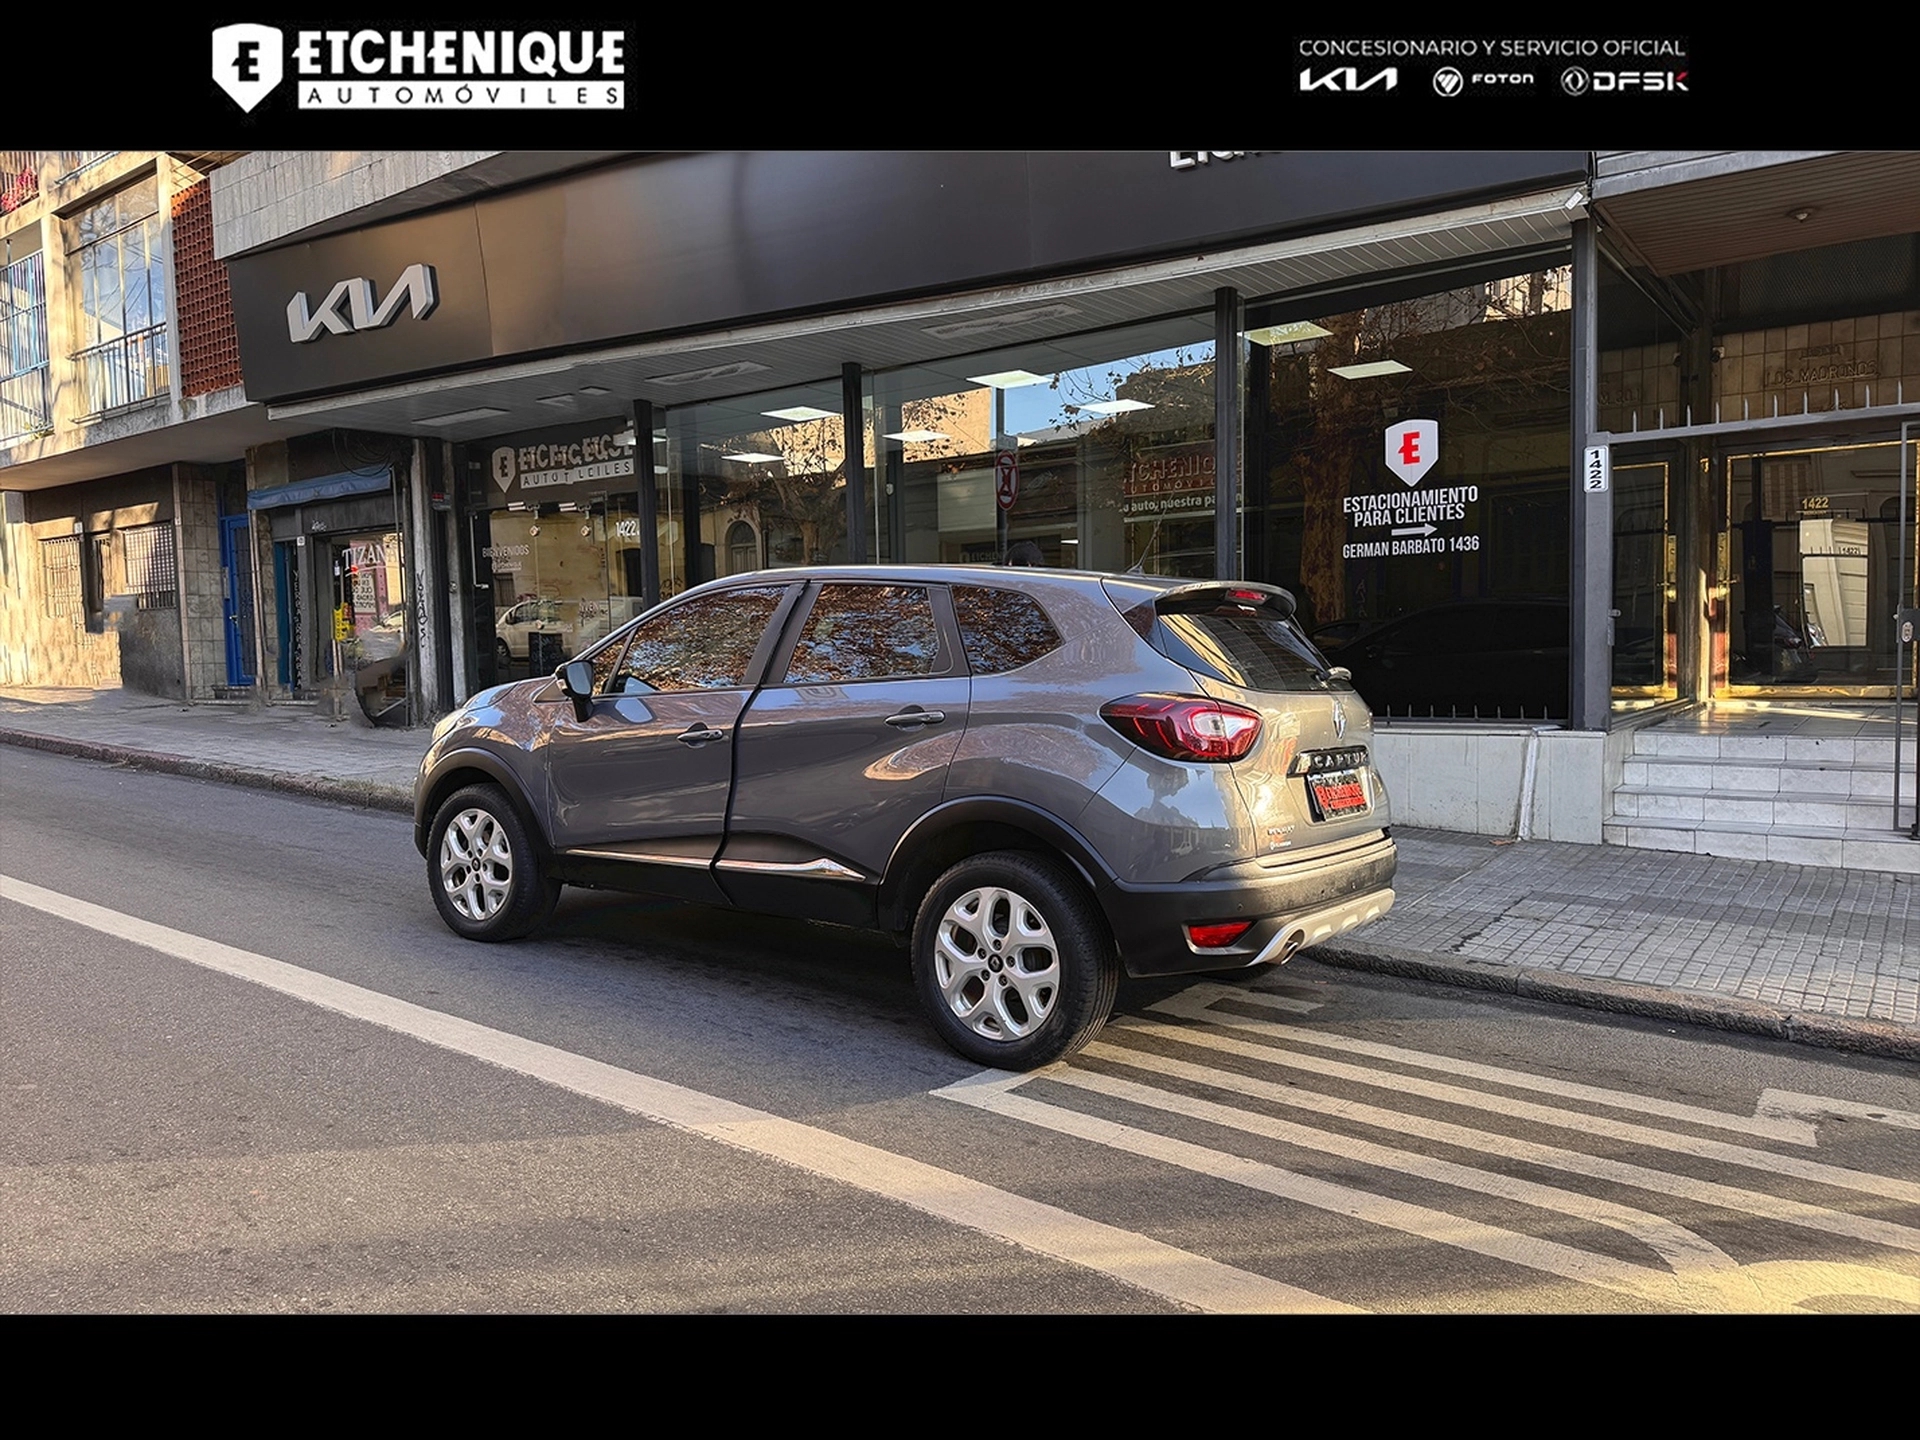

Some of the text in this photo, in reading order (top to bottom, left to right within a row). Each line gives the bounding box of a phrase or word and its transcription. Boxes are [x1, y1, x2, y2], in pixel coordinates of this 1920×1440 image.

[286, 263, 434, 343] KIA
[1590, 450, 1602, 489] 1422
[1343, 485, 1478, 513] ESTACIONAMIENTO
[1802, 496, 1829, 509] 1422
[1354, 503, 1466, 527] PARA CLIENTES
[1342, 535, 1480, 559] GERMAN BARBATO 1436
